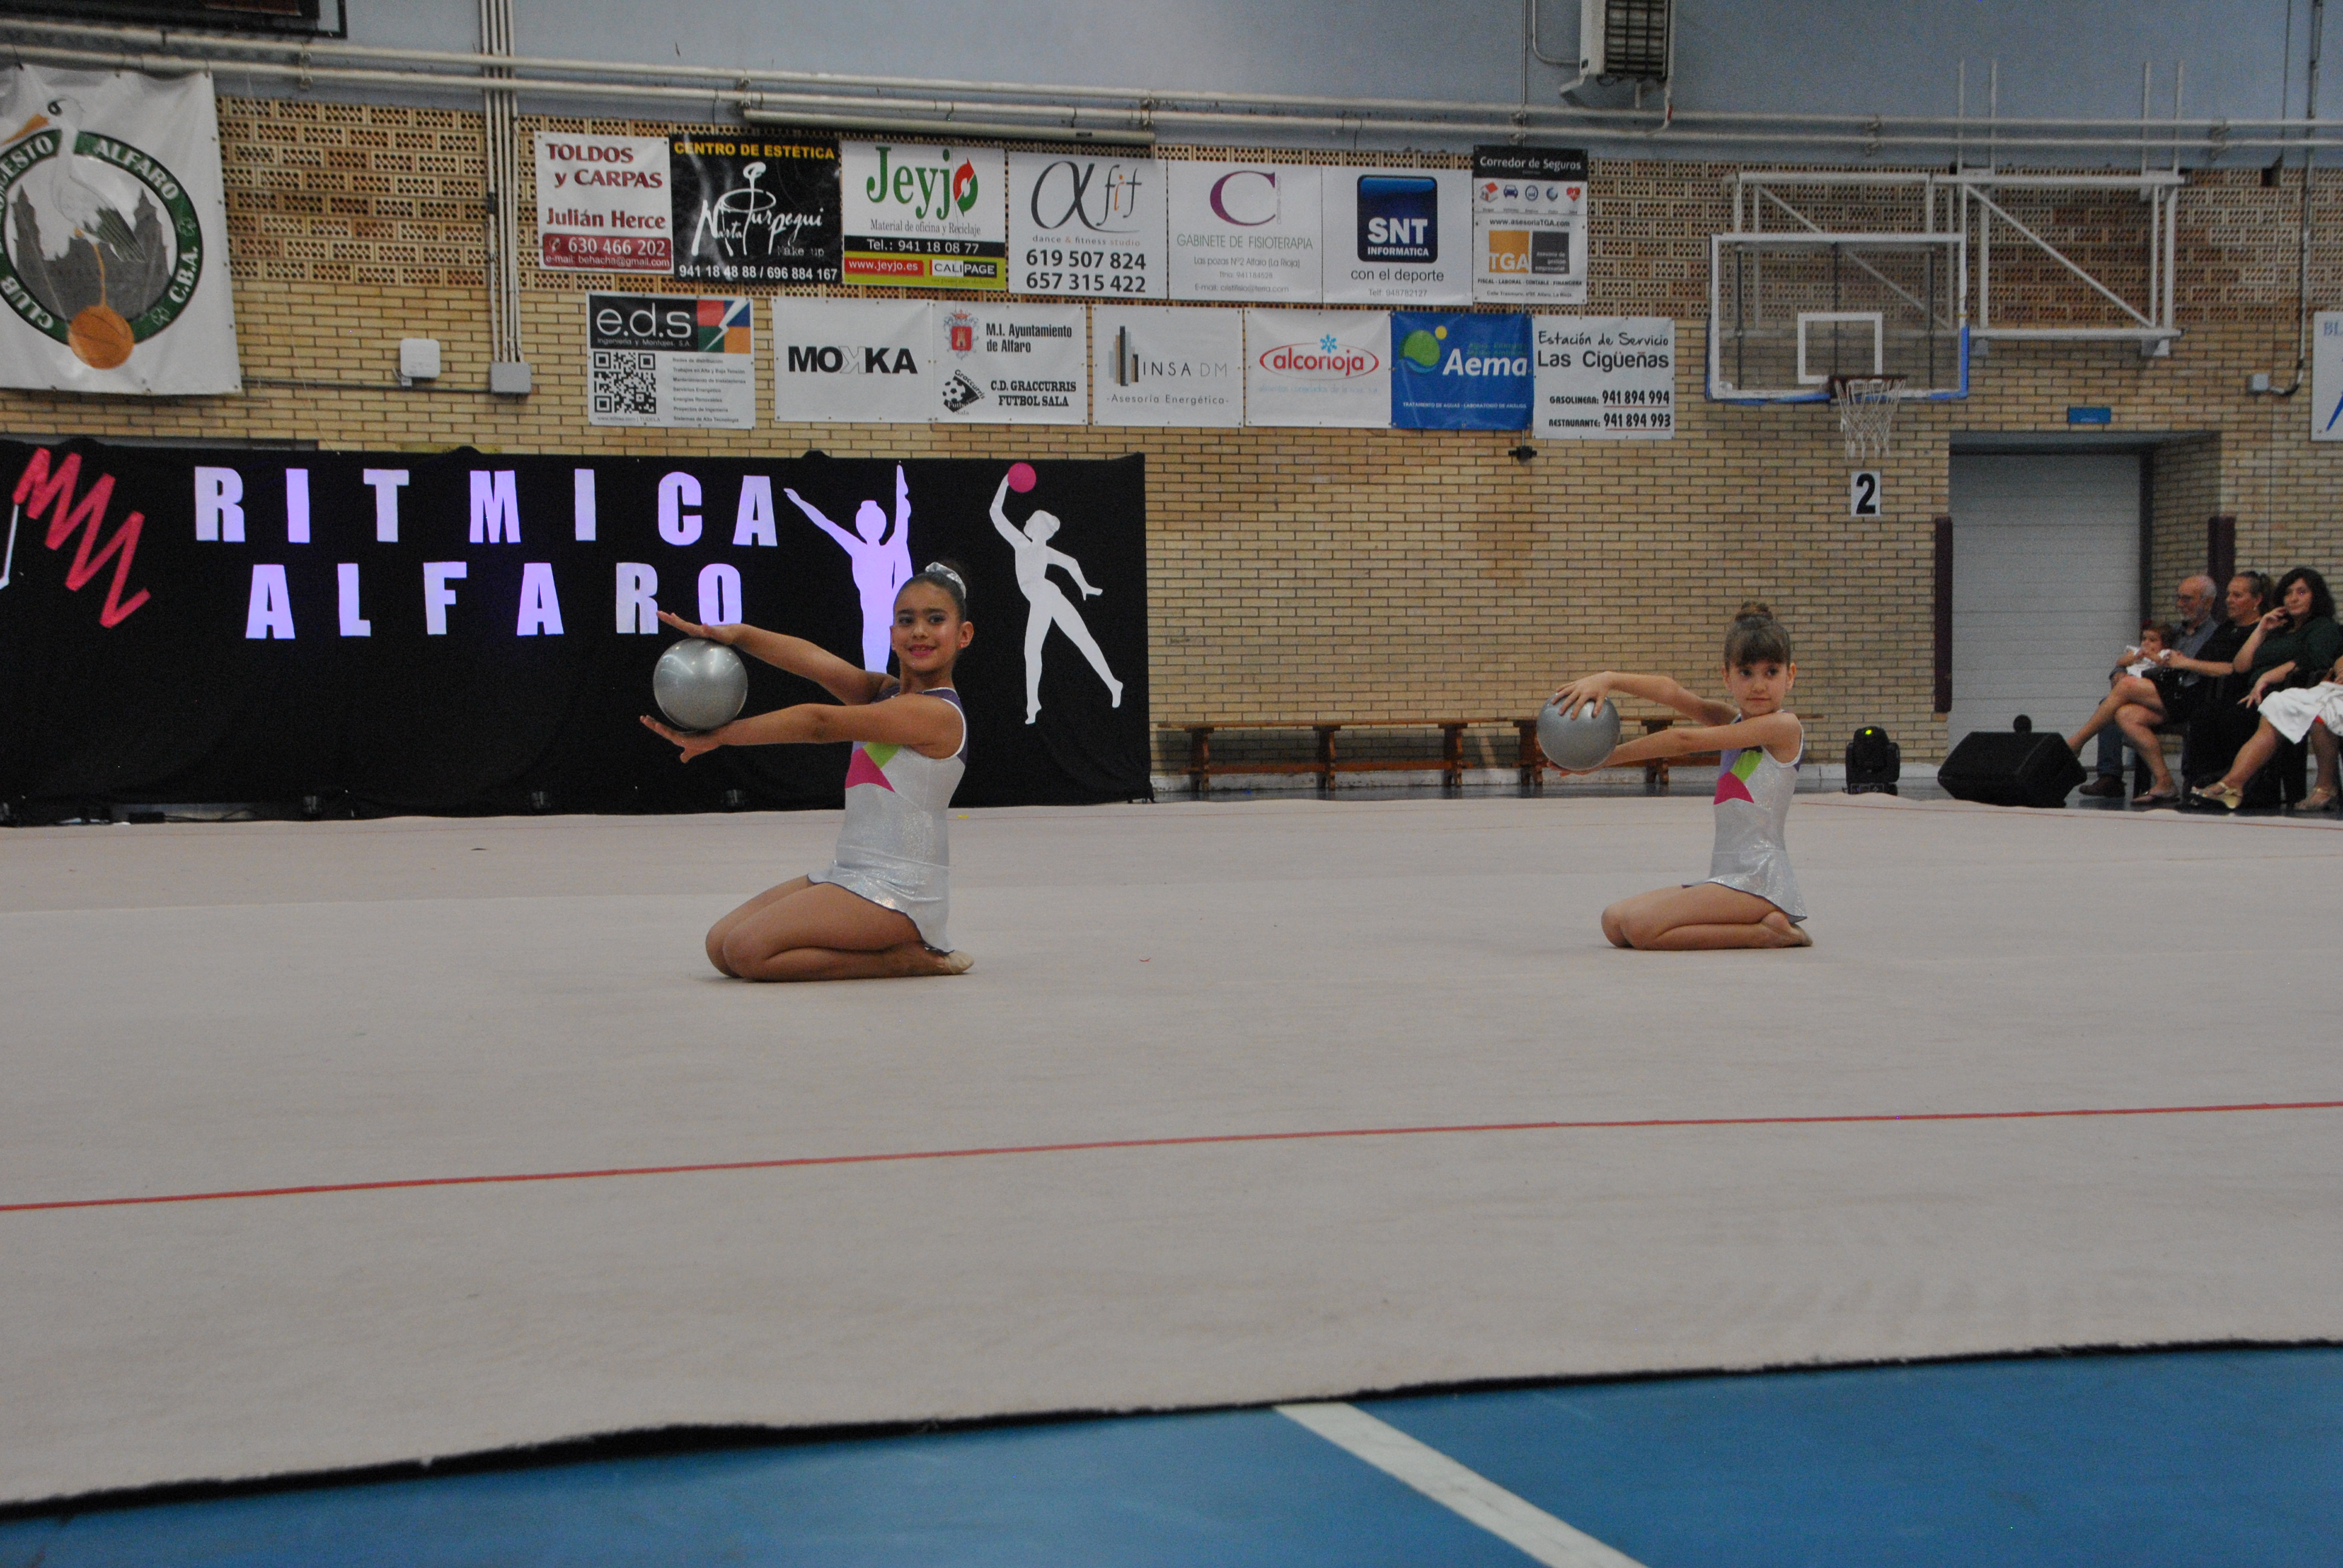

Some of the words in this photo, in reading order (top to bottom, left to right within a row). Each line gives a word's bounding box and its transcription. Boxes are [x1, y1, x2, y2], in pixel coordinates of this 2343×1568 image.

[546, 143, 634, 163] TOLDOS
[673, 142, 736, 156] CENTRO
[740, 143, 760, 157] DE
[764, 144, 835, 160] ESTÉTICA
[94, 139, 180, 201] ALFARO
[1480, 156, 1525, 167] Corredor
[1529, 157, 1540, 168] de
[1543, 159, 1581, 171] Seguros
[554, 172, 567, 189] y
[574, 169, 663, 189] CARPAS
[546, 207, 604, 227] Julián
[611, 210, 666, 229] Herce
[870, 219, 903, 232] Material
[905, 221, 914, 232] de
[916, 221, 940, 233] oficina
[943, 226, 946, 236] y
[949, 223, 981, 236] Reciclaje
[1368, 217, 1427, 244] SNT
[568, 237, 598, 253] 630
[603, 240, 632, 255] 466
[637, 240, 666, 256] 202
[867, 238, 893, 251] Tel.:
[898, 240, 920, 252] 941
[927, 242, 940, 253] 18
[945, 243, 960, 253] 08
[965, 243, 979, 255] 77
[1075, 237, 1106, 245] fitness
[1177, 234, 1226, 247] GABINETE
[1230, 235, 1242, 248] DE
[1249, 236, 1313, 249] FISIOTERAPIA
[811, 249, 824, 258] up
[1026, 249, 1063, 266] 619
[1069, 250, 1104, 268] 507
[1110, 252, 1146, 270] 824
[1368, 246, 1429, 256] INFORMATICA
[578, 255, 669, 267] behacha@gmail.com
[849, 260, 918, 272] www.jeyjo.es
[934, 263, 994, 275] CALIPAGE
[1246, 258, 1267, 266] Alfaro
[1268, 258, 1279, 267] (La
[1281, 258, 1300, 268] Rioja)
[1489, 253, 1529, 270] TGA
[169, 246, 198, 303] C.B.A.
[679, 265, 701, 277] 941
[706, 265, 720, 277] 18
[724, 265, 738, 278] 48
[742, 266, 756, 278] 88
[767, 266, 788, 279] 696
[791, 267, 813, 280] 884
[818, 268, 837, 280] 167
[1351, 270, 1374, 280] con
[1379, 269, 1389, 280] el
[1395, 269, 1444, 283] deporte
[1026, 272, 1063, 289] 657
[1069, 273, 1104, 291] 315
[1110, 275, 1145, 292] 422
[1, 275, 54, 329] CLUB
[597, 302, 692, 338] e.d.s
[986, 322, 1005, 336] M.I.
[1009, 323, 1072, 339] Ayuntamiento
[1538, 331, 1591, 345] Estación
[1598, 333, 1613, 345] de
[1619, 332, 1668, 345] Servicio
[986, 339, 998, 352] de
[1001, 339, 1031, 353] Alfaro
[1143, 362, 1191, 376] INSA
[1200, 363, 1227, 377] DM
[1273, 347, 1364, 376] alcorioja
[1443, 348, 1527, 376] Aema
[1538, 350, 1571, 367] Las
[1582, 350, 1669, 373] Cigüeñas
[991, 380, 1009, 391] C.D.
[1011, 381, 1076, 392] GRACCURRIS
[998, 395, 1040, 407] FUTBOL
[1041, 396, 1069, 407] SALA
[1602, 390, 1621, 404] 941
[1625, 390, 1645, 405] 894
[1649, 390, 1669, 405] 994
[1548, 419, 1600, 427] RESTAURANTE:
[1604, 413, 1622, 427] 941
[1626, 413, 1647, 427] 894
[1650, 413, 1671, 427] 993
[1856, 474, 1876, 514] 2
[195, 466, 778, 547] RITMICA
[245, 562, 742, 639] ALFARO
